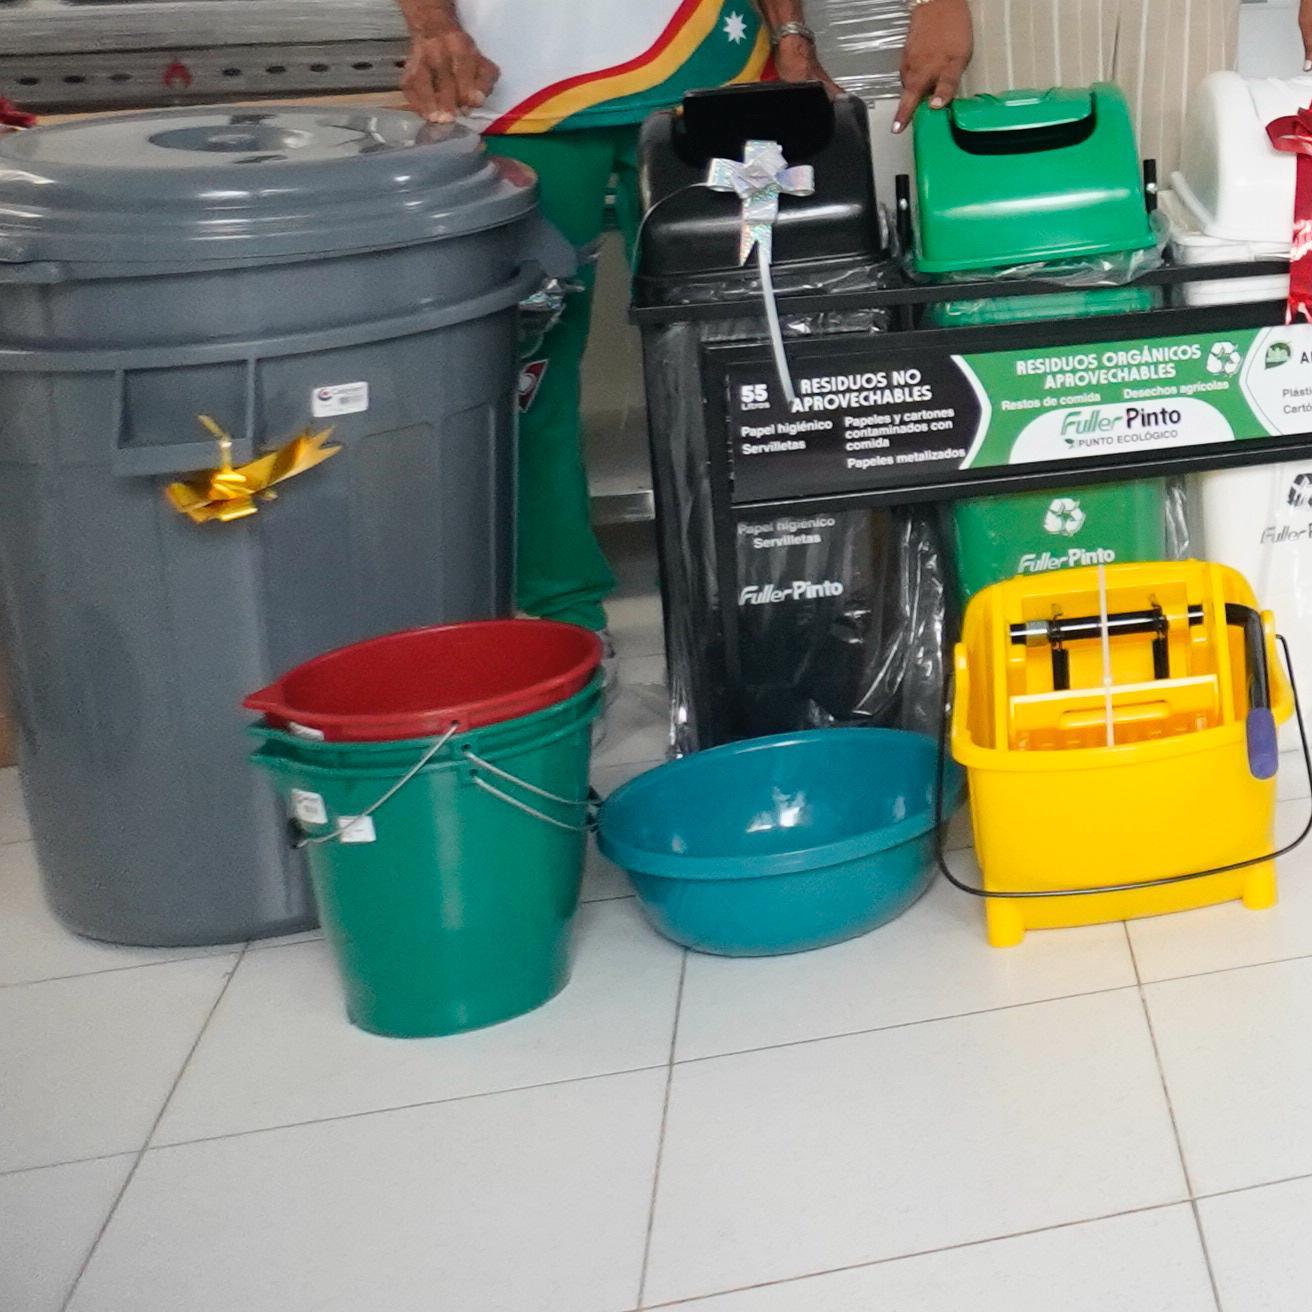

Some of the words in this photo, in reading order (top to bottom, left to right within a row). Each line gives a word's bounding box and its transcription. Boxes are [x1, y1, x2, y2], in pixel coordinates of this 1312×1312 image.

[1015, 353, 1098, 376] RESIDUOS
[1102, 343, 1202, 368] ORGÁNICOS
[800, 372, 888, 395] RESIDUOS
[891, 368, 922, 386] NO
[1044, 363, 1177, 390] APROVECHABLES
[740, 383, 769, 402] 55
[791, 385, 933, 413] APROVECHABLES
[1001, 399, 1041, 411] Restos
[1043, 396, 1058, 407] de
[1061, 392, 1101, 405] comida
[1123, 385, 1178, 400] Desechos
[740, 424, 776, 438] Papel
[777, 419, 834, 437] higiénico
[844, 415, 892, 431] Papeles
[893, 413, 902, 425] y
[904, 408, 955, 423] cartones
[845, 423, 928, 440] contaminados
[930, 420, 953, 431] con
[741, 439, 807, 456] Servilletas
[845, 437, 890, 452] comida
[1078, 436, 1114, 448] PUNTO
[847, 454, 894, 470] Papeles
[896, 447, 966, 465] metalizados
[753, 534, 822, 549] Servilletas
